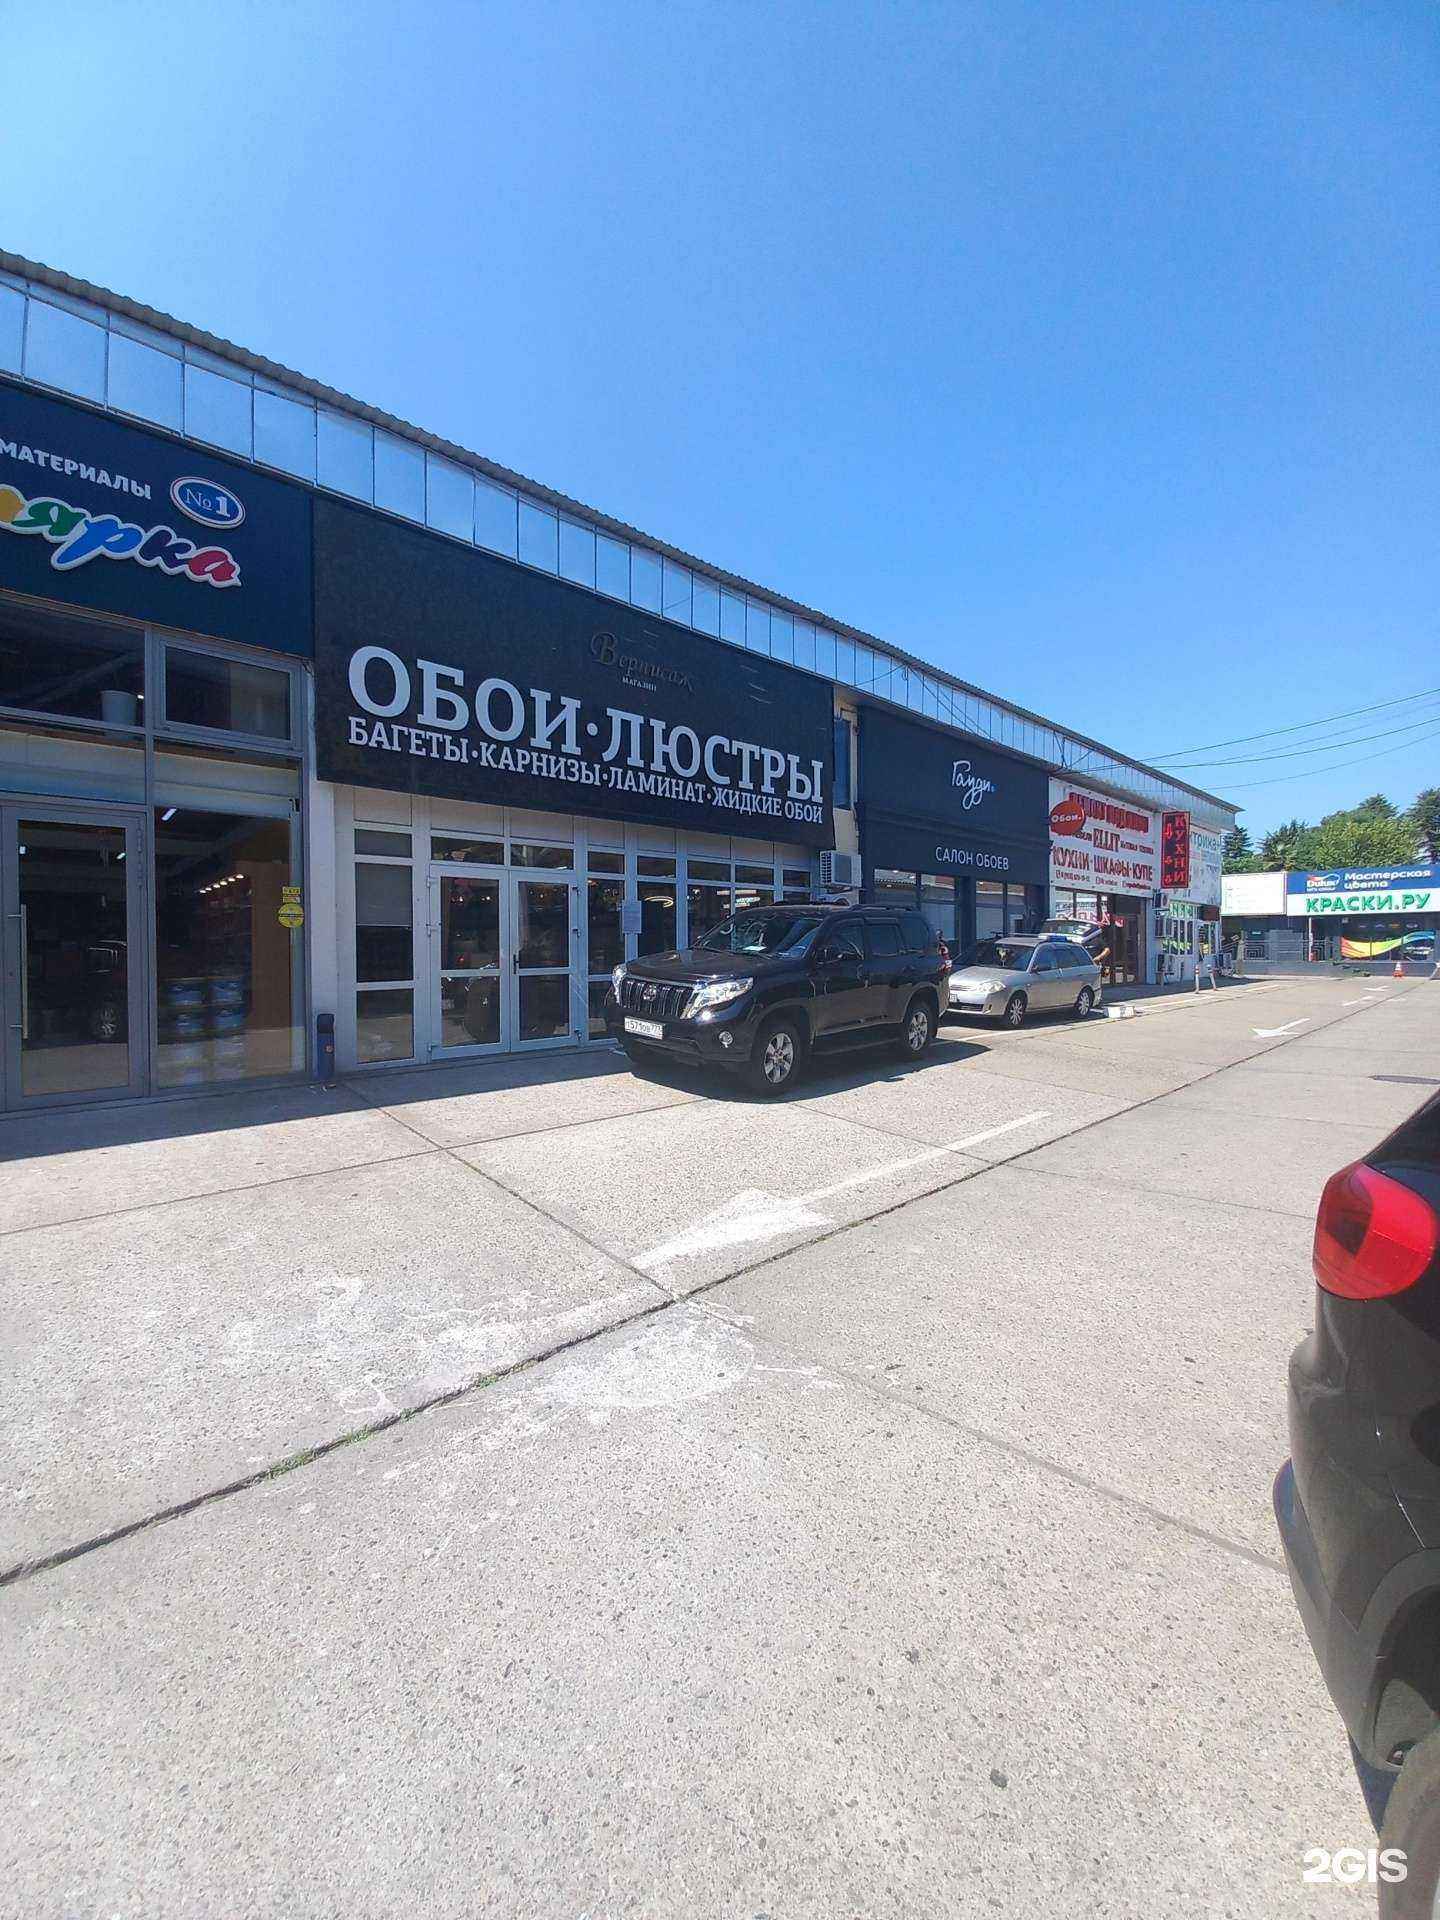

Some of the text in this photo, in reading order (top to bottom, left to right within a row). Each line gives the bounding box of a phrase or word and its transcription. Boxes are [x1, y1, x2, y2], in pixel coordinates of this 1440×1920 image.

[621, 675, 658, 693] МАГАЗИН
[784, 803, 824, 825] ОБОИ
[935, 846, 1010, 871] САЛОН ОБОЕВ
[1174, 815, 1186, 883] КУХНИ
[1344, 869, 1432, 882] Мастерская
[1344, 880, 1389, 891] цвета
[1305, 893, 1431, 913] КРАСКИ.РУ
